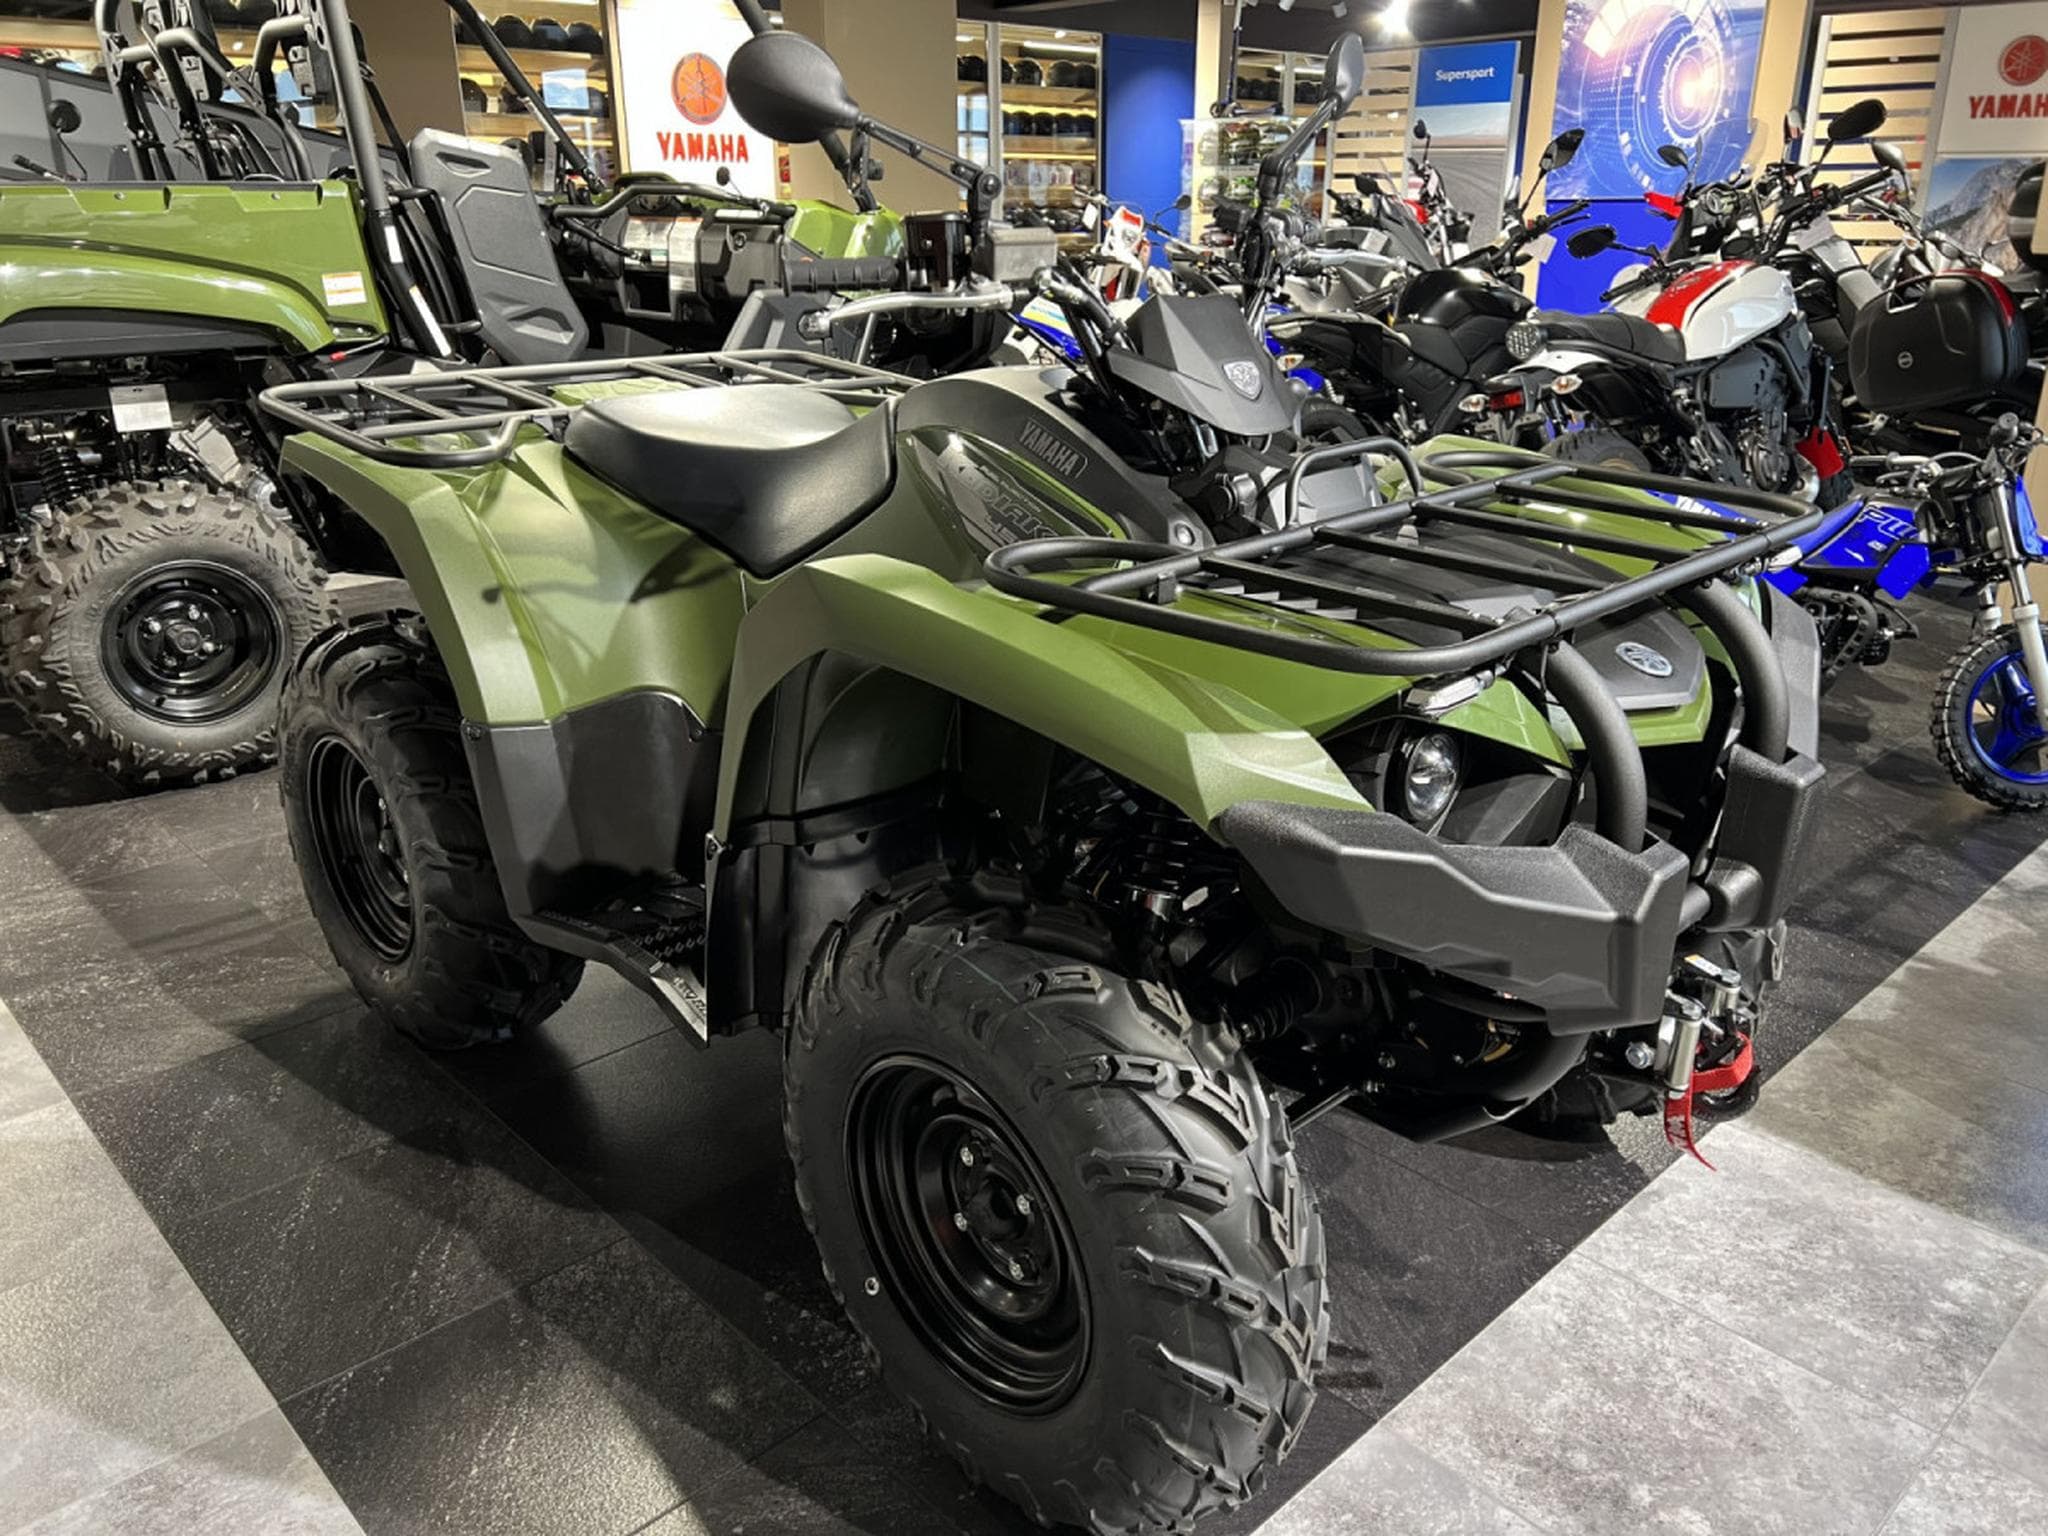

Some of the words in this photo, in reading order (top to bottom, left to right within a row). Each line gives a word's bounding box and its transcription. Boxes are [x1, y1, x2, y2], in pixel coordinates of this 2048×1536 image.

[1435, 66, 1496, 82] Supersport
[656, 131, 749, 162] YAMAHA
[1019, 421, 1081, 476] YAMAHA
